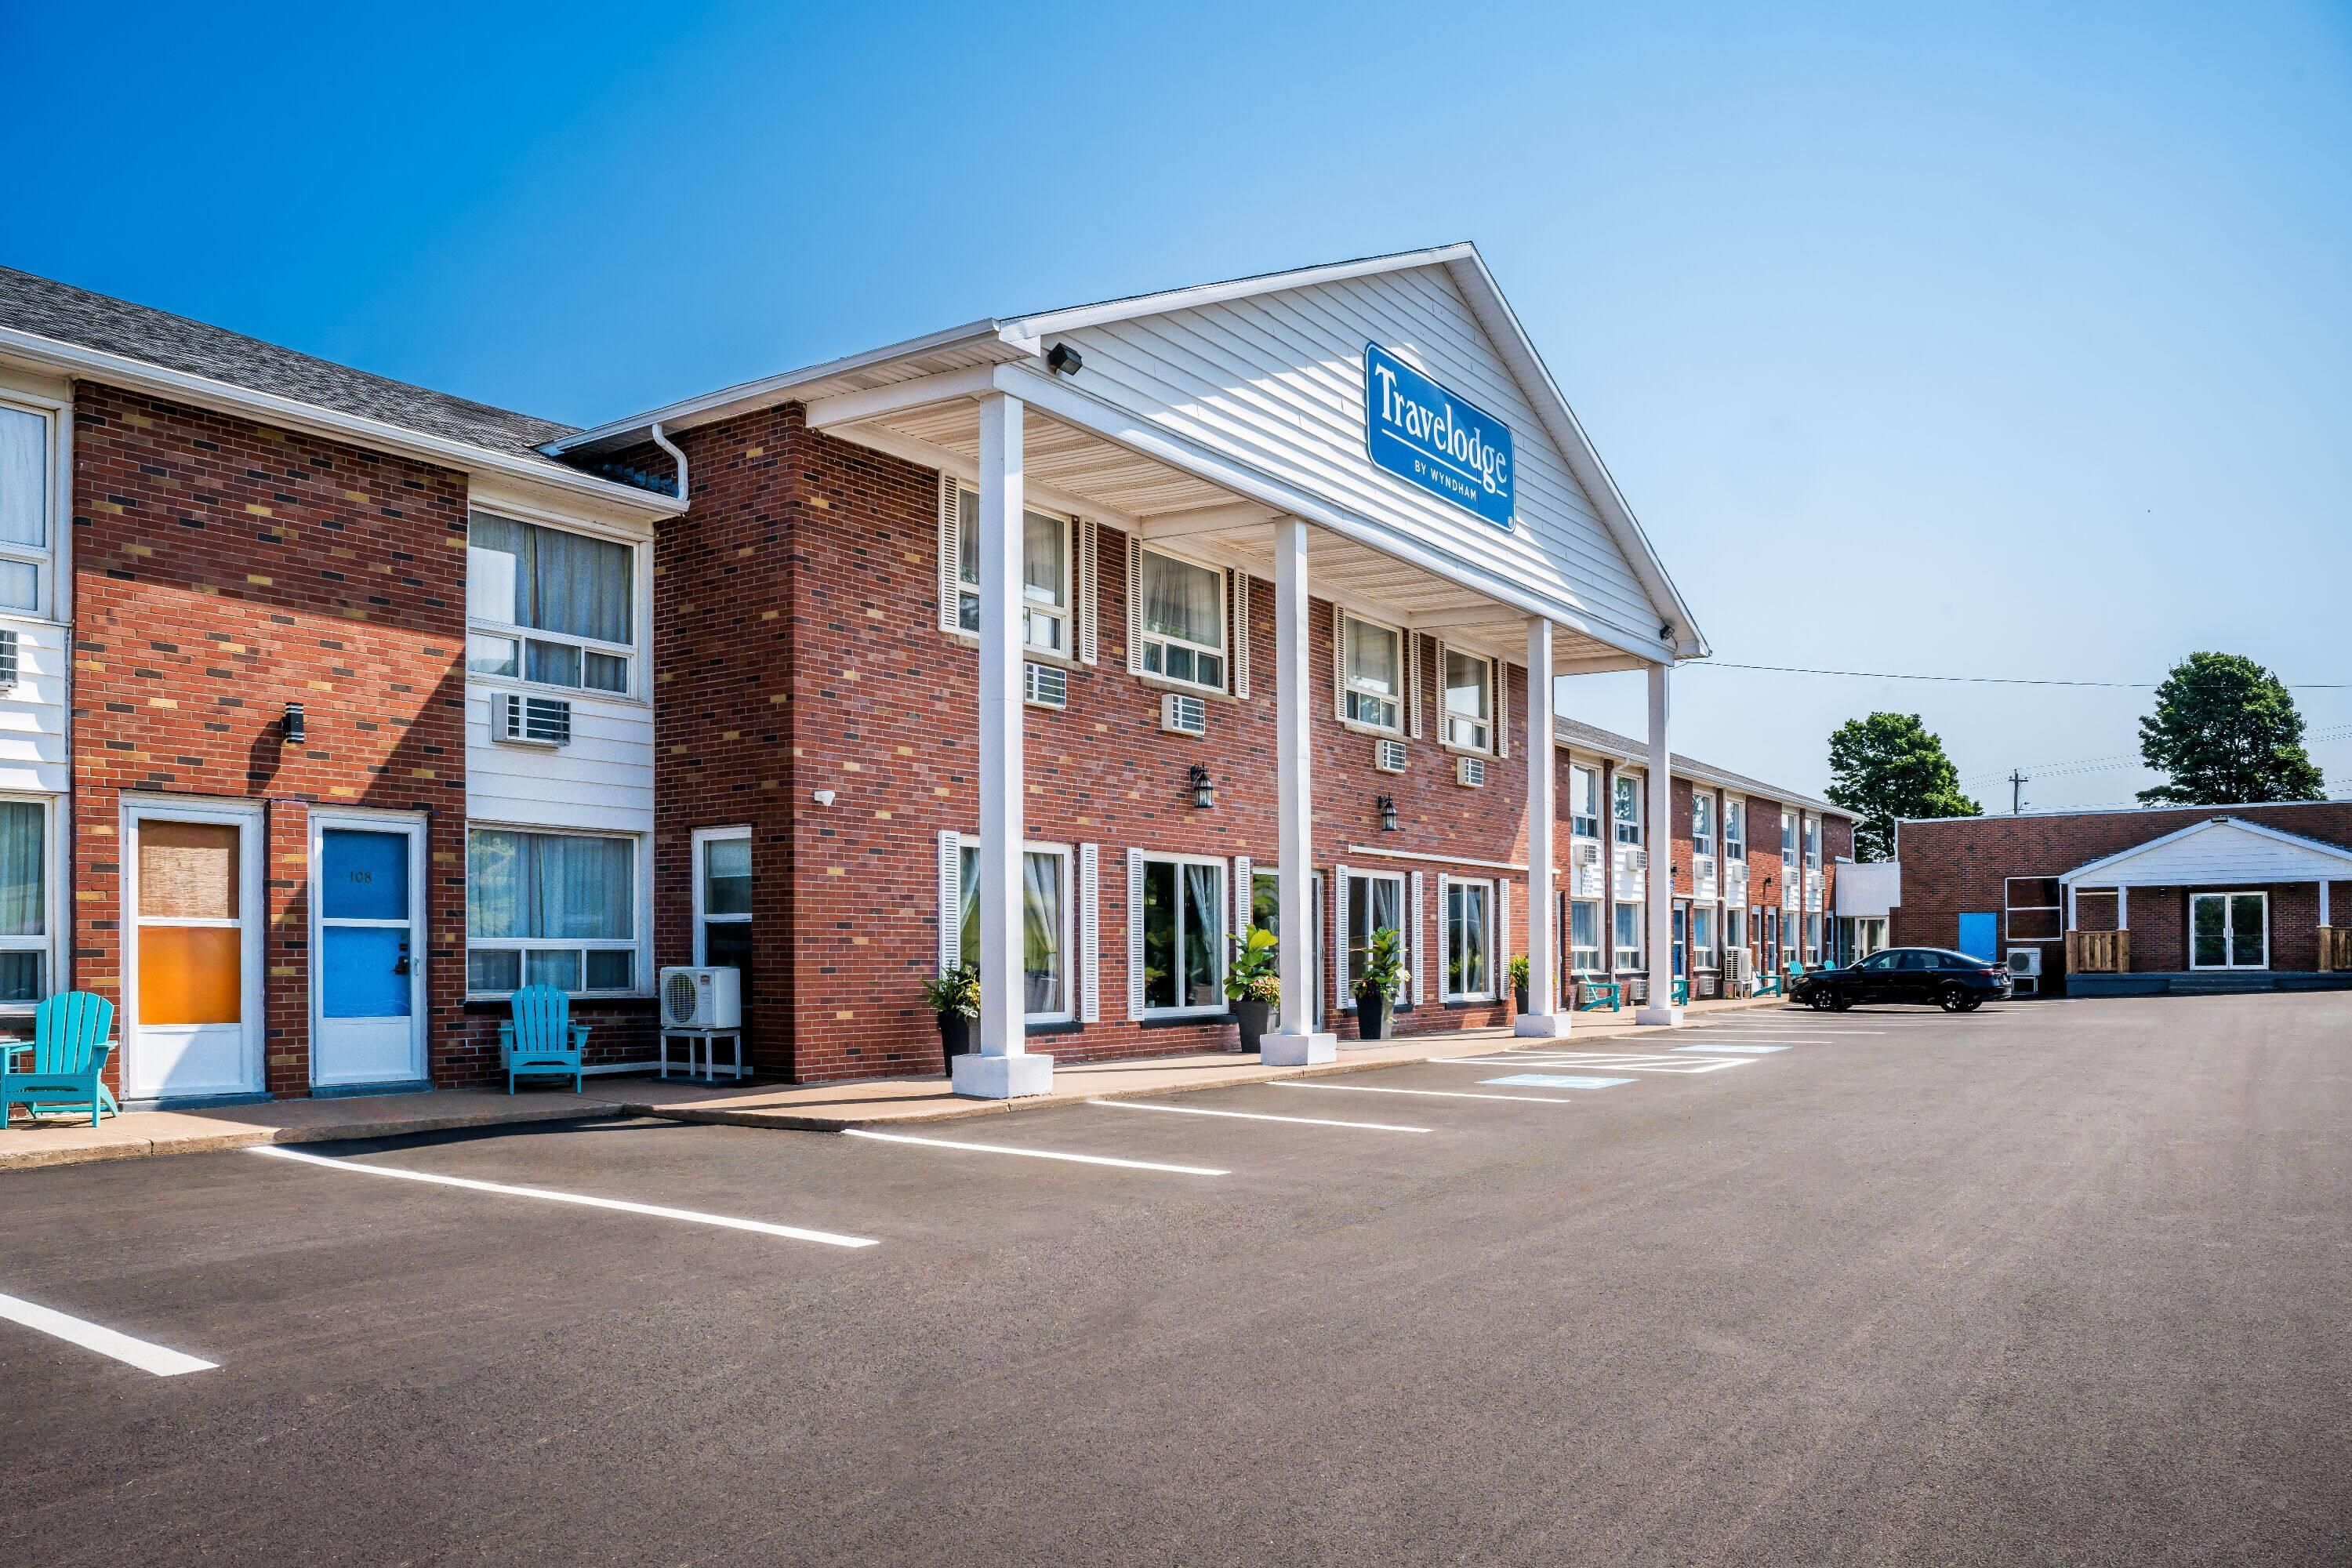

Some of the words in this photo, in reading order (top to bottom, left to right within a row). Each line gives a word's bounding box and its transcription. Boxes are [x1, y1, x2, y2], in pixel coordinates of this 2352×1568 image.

[1375, 362, 1507, 494] Travelodge
[1414, 459, 1426, 475] BY
[1430, 467, 1476, 502] WYNDHAM
[350, 870, 372, 884] 108
